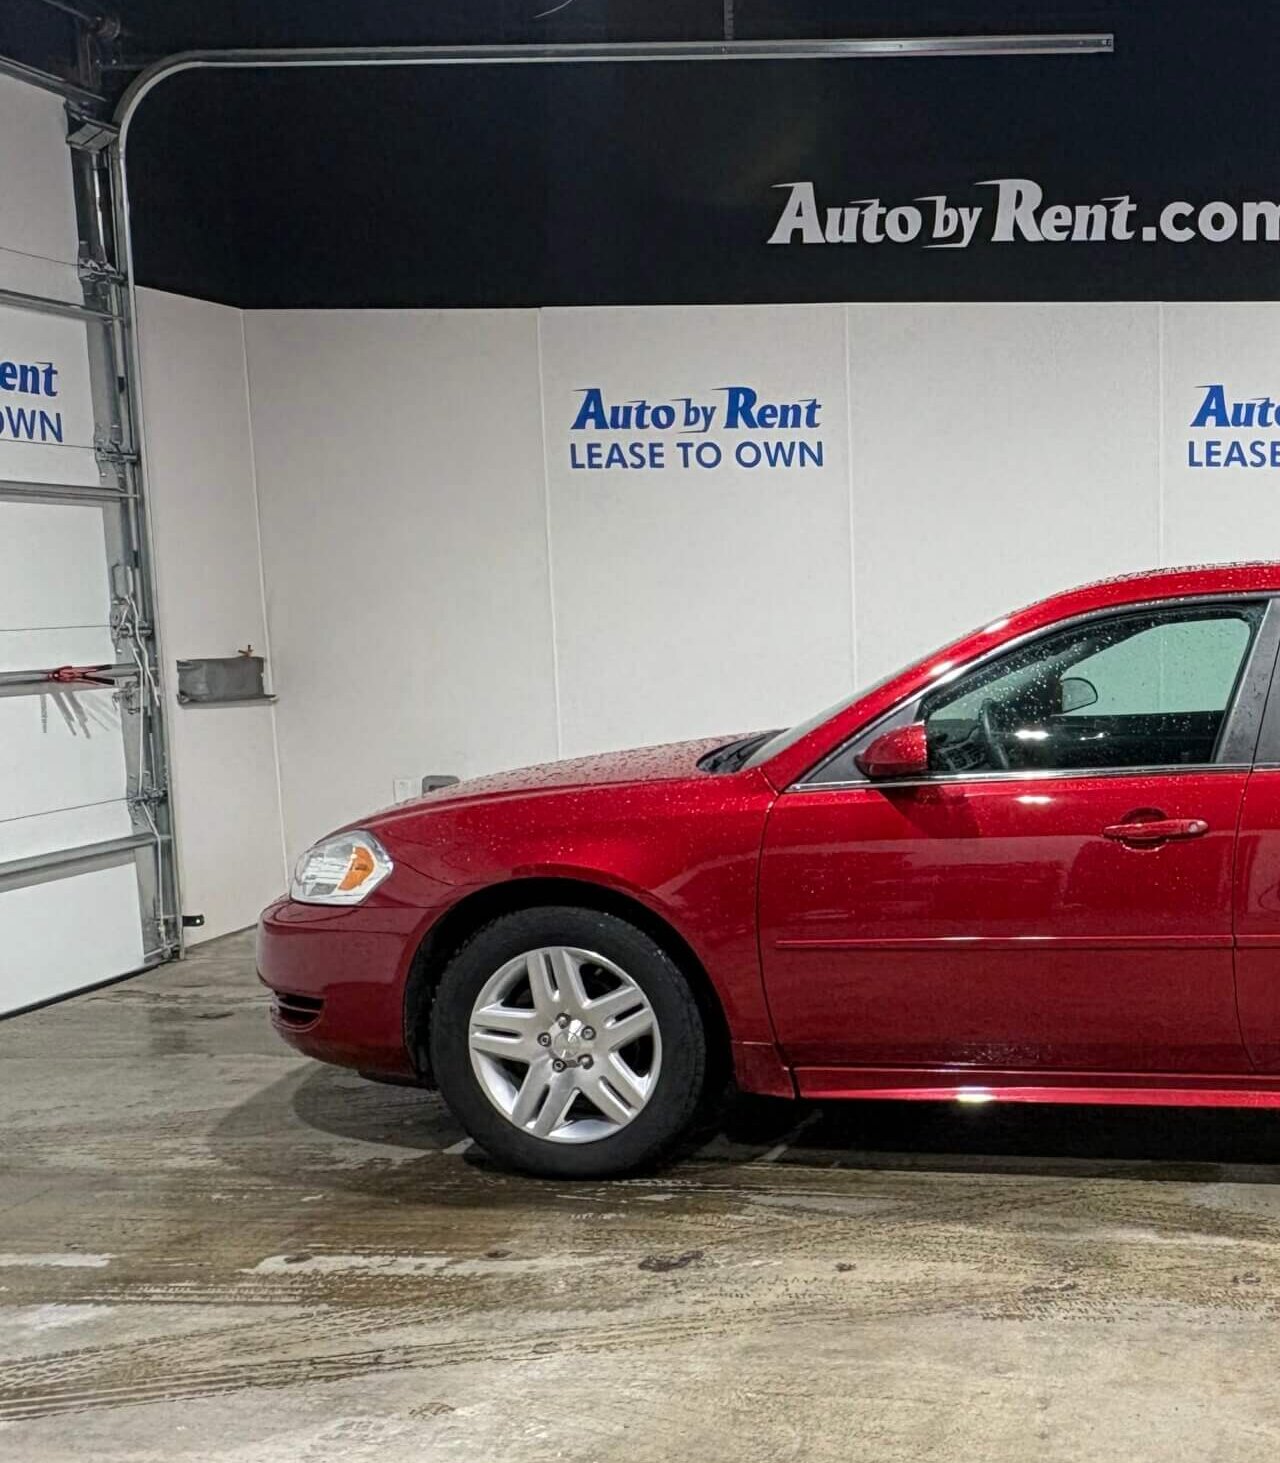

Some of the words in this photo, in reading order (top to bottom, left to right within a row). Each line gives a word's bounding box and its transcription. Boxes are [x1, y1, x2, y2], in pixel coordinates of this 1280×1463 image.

[767, 181, 922, 245] Auto
[913, 196, 983, 249] by
[0, 361, 58, 397] ent
[0, 405, 63, 443] WN
[570, 387, 676, 430] Auto
[671, 397, 717, 434] by
[711, 386, 822, 429] Rent
[570, 442, 664, 469] LEASE
[676, 441, 722, 469] TO
[735, 440, 824, 468] OWN
